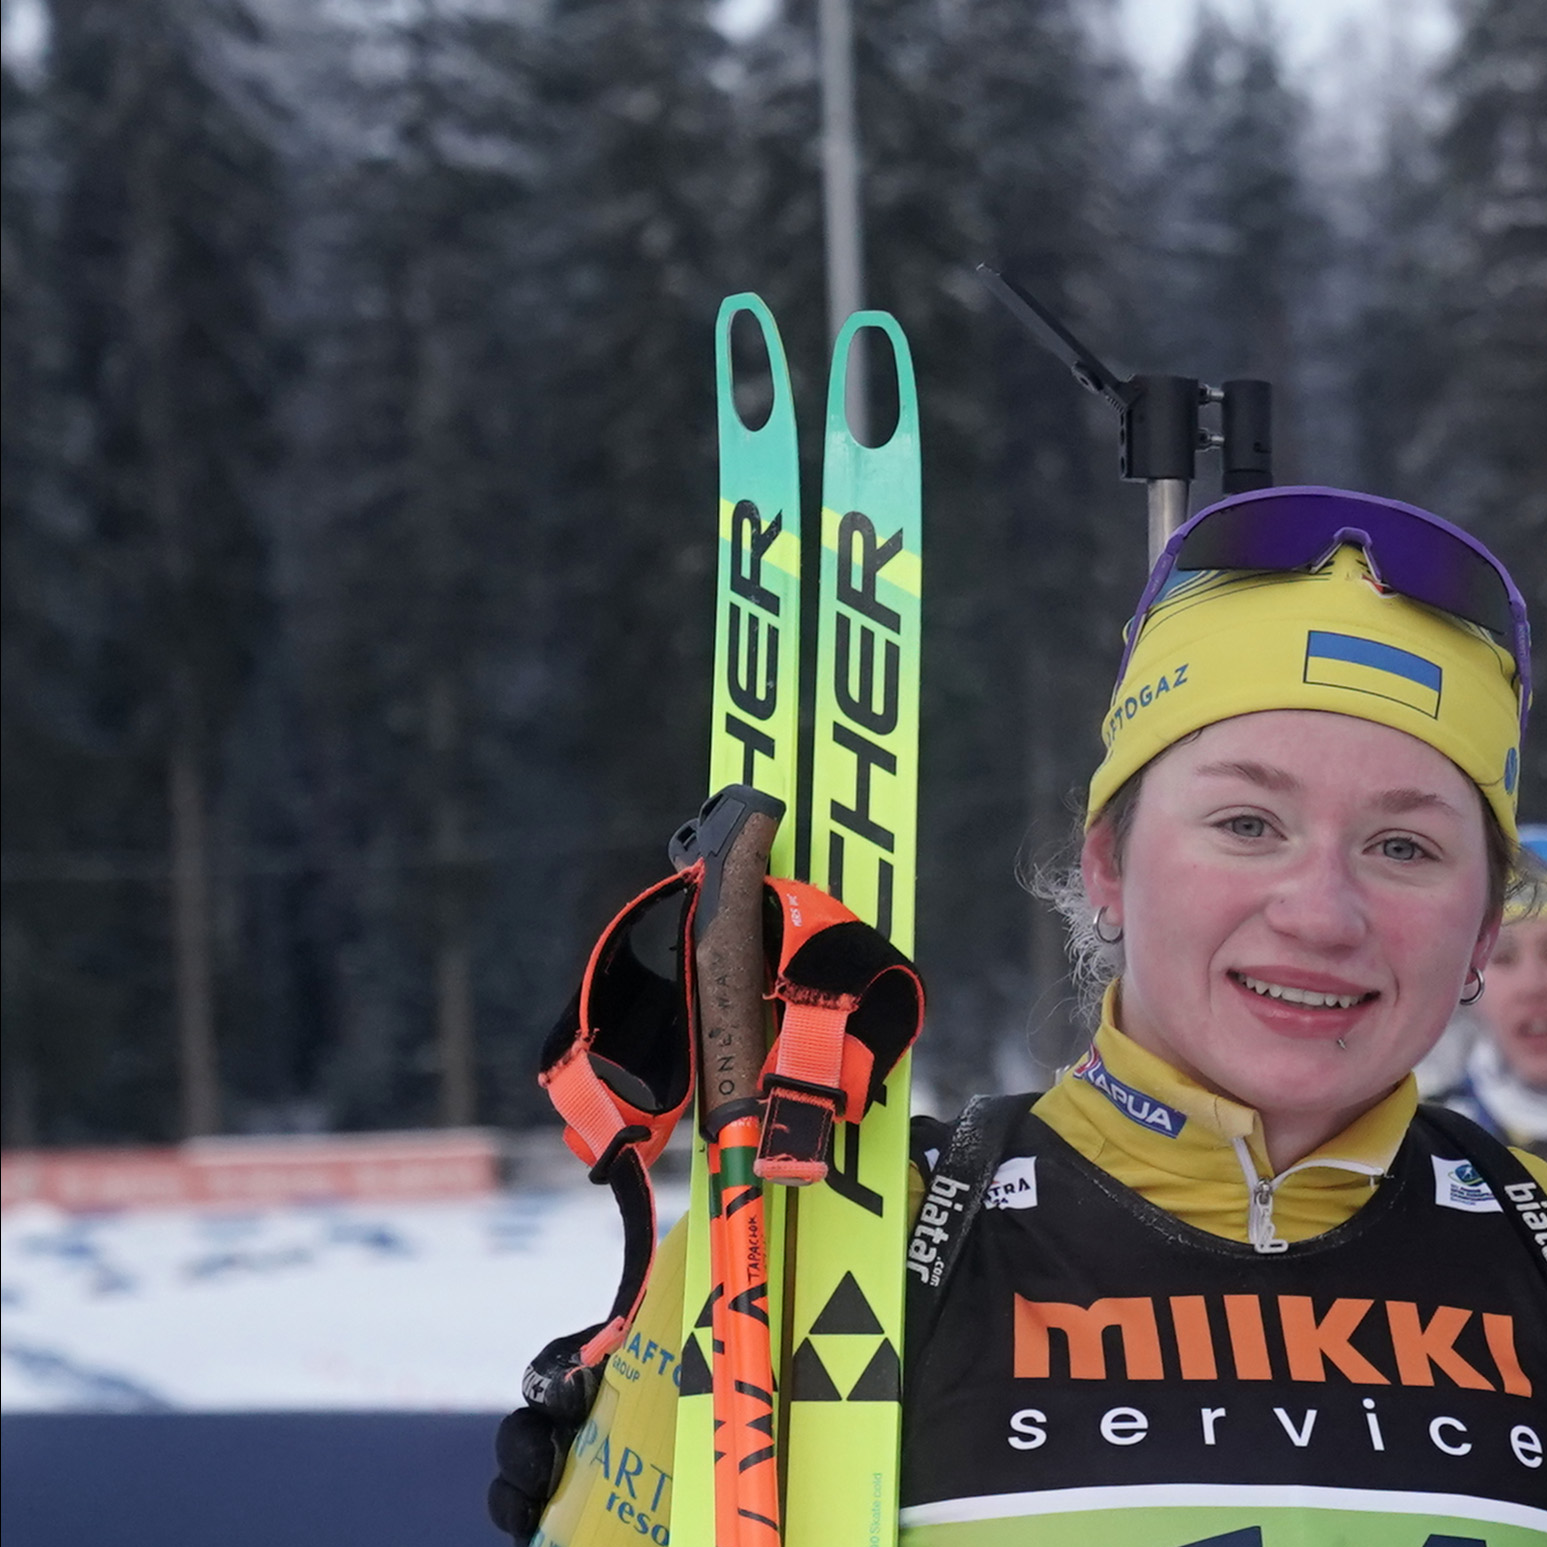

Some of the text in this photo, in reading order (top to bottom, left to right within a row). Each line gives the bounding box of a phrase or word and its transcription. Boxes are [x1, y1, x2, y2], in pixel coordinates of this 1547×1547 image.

[906, 1174, 970, 1287] biatar .com
[1013, 1293, 1533, 1398] MIIKKI
[1008, 1397, 1544, 1470] service
